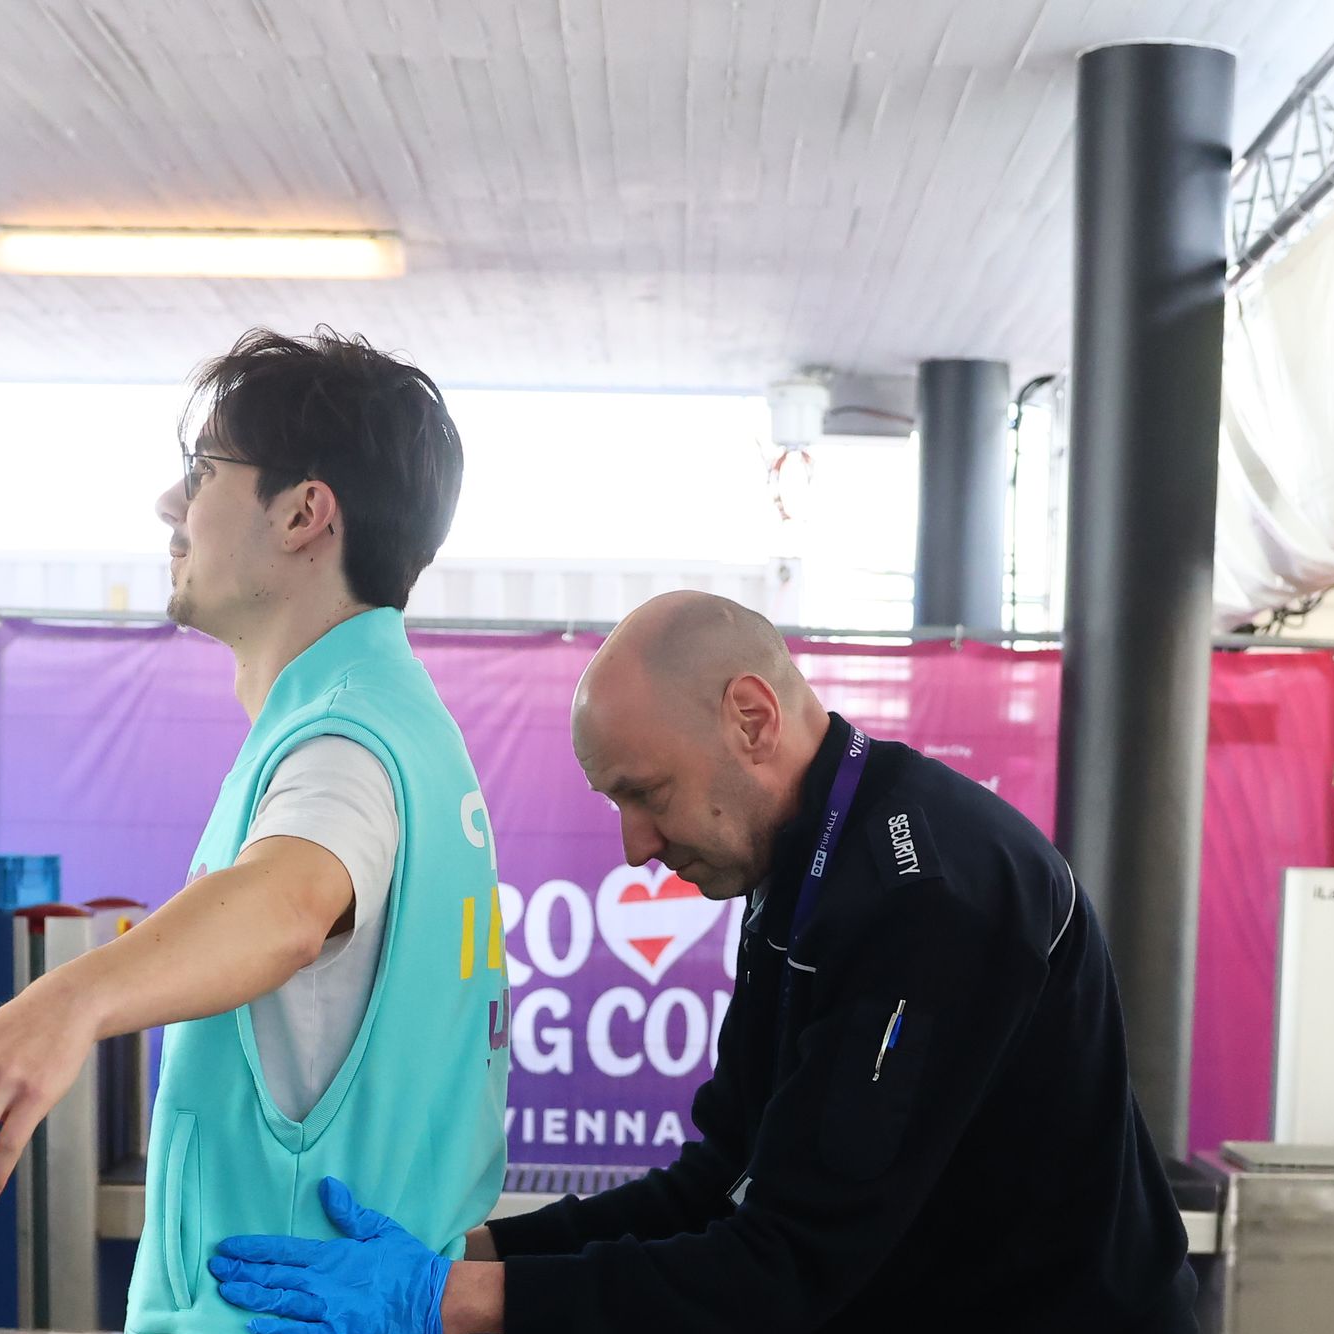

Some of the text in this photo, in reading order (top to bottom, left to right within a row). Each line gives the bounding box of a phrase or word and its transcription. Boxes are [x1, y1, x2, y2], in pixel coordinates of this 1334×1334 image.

[811, 850, 827, 877] ORF
[825, 810, 839, 834] ALLE
[887, 813, 921, 876] SECURITY
